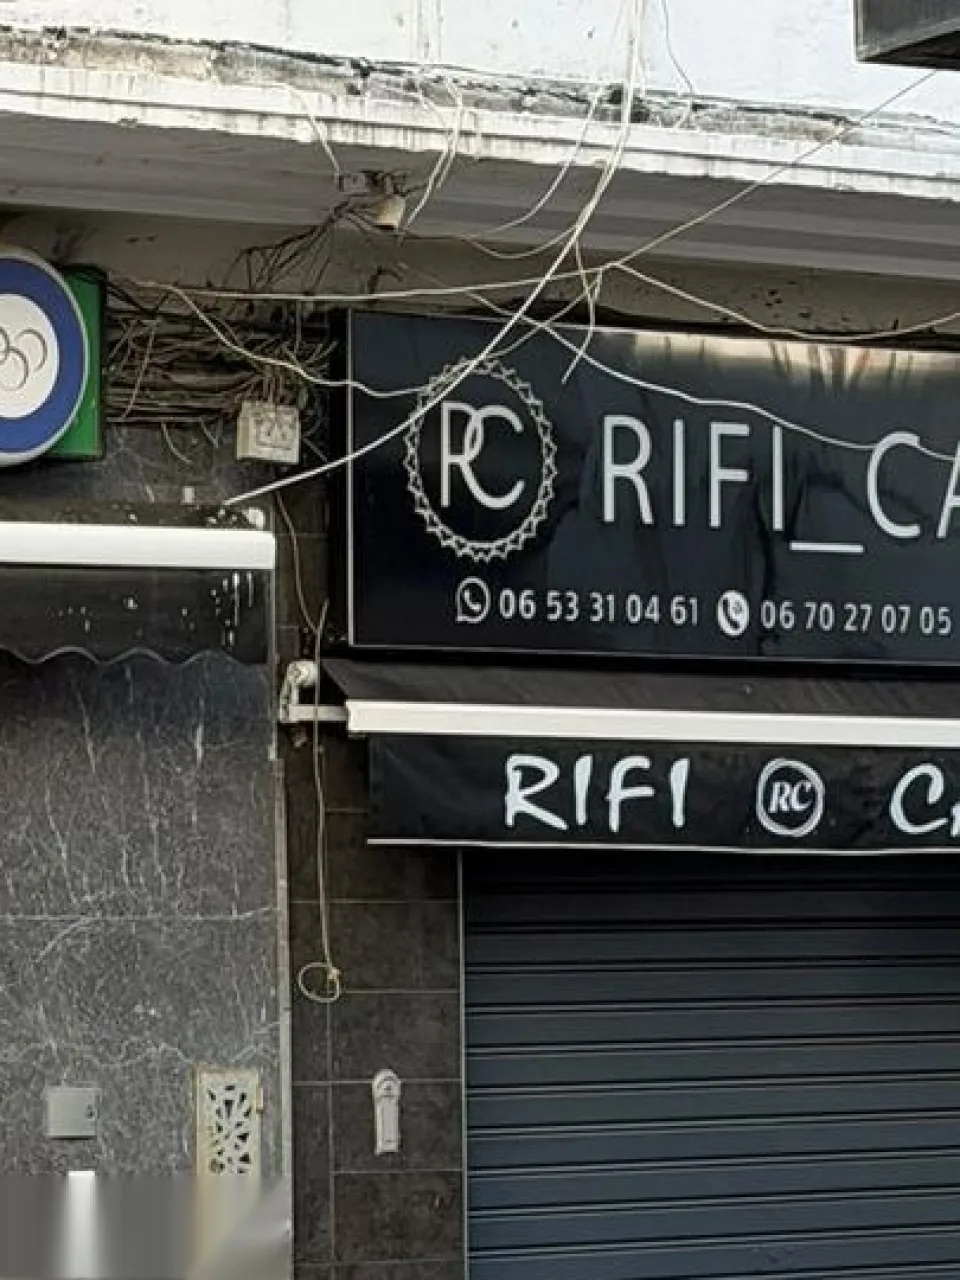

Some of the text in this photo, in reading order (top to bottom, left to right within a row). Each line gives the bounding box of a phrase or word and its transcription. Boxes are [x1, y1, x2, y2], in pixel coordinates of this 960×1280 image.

[440, 402, 525, 509] RC
[499, 588, 698, 626] 06 53 31 04 61
[761, 600, 952, 635] 06 70 27 07 05
[504, 755, 960, 838] RIFI RC C
